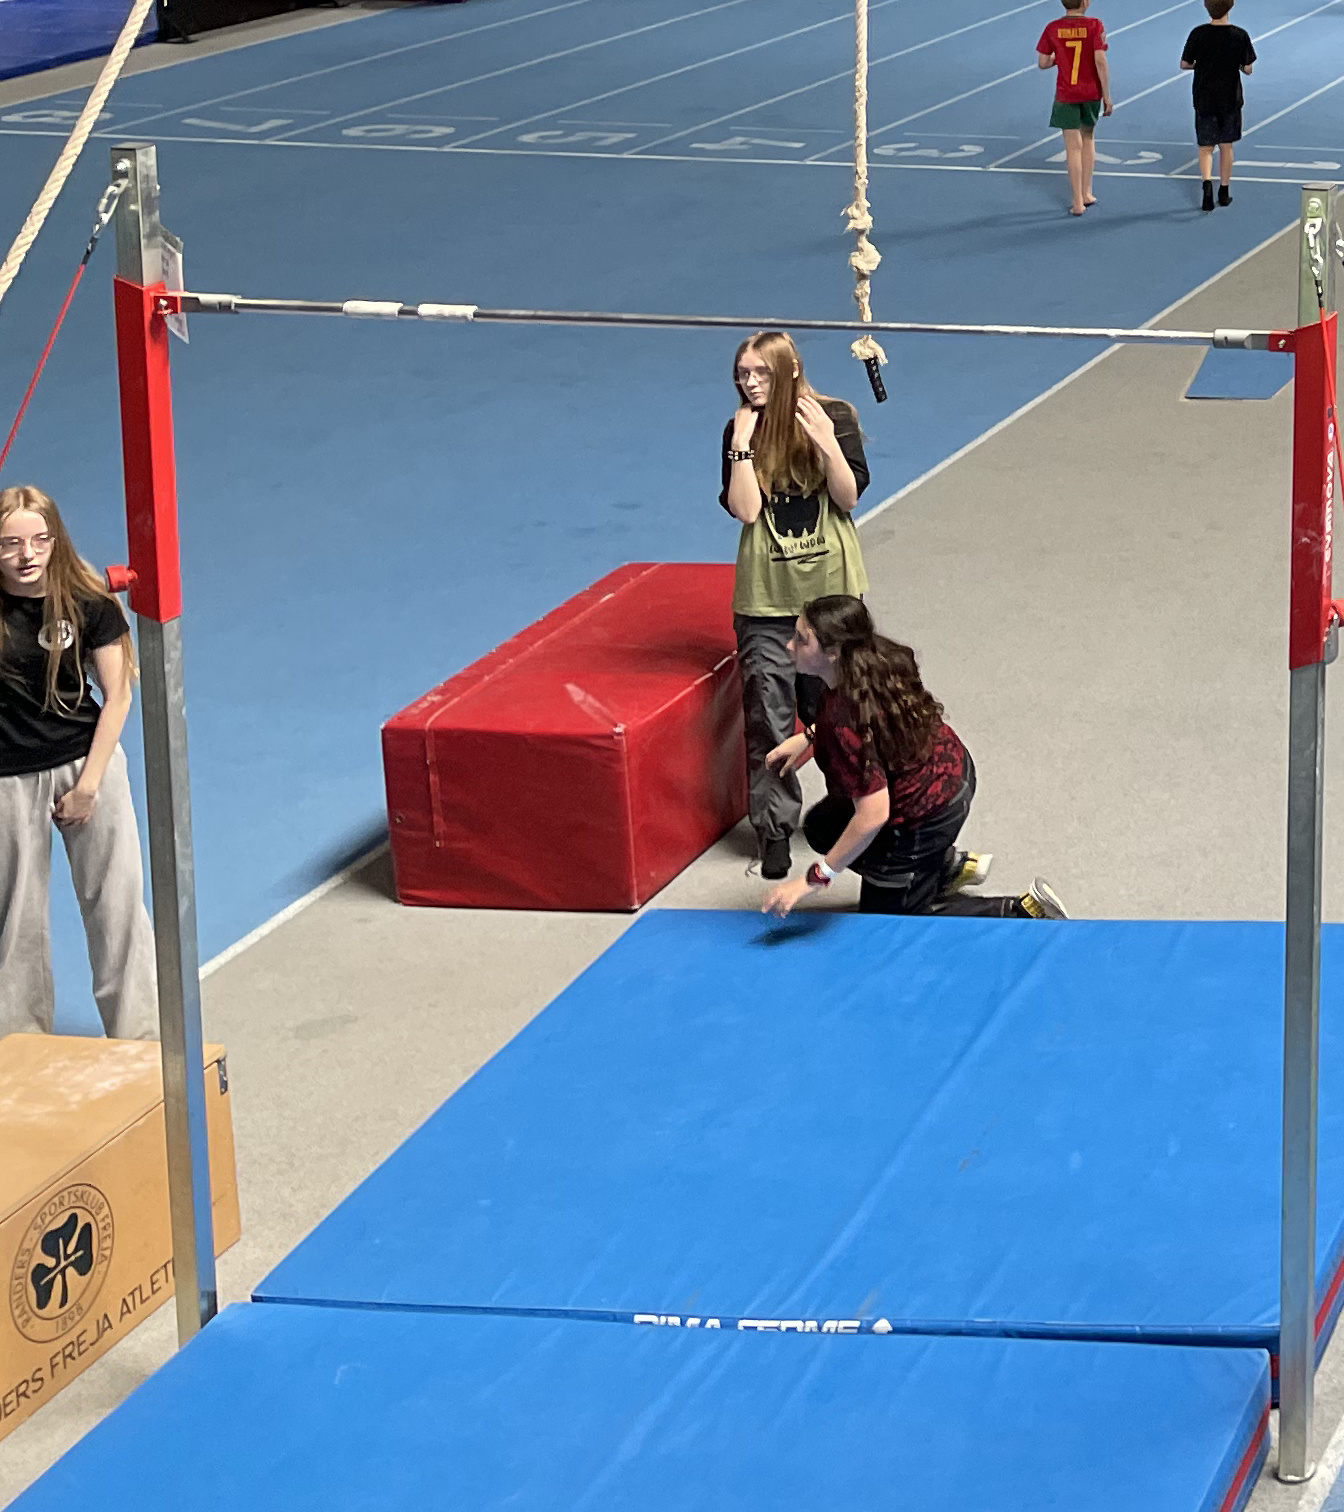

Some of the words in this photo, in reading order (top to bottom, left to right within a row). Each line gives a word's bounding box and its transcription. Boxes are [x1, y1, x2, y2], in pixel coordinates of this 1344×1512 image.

[1065, 40, 1083, 86] 7
[12, 1247, 33, 1330] RANDERS
[33, 1188, 105, 1232] SPORTSKLUB
[97, 1213, 113, 1265] FREJA
[55, 1302, 84, 1334] 1898
[0, 1367, 44, 1422] ERS
[49, 1312, 113, 1379] FREJA
